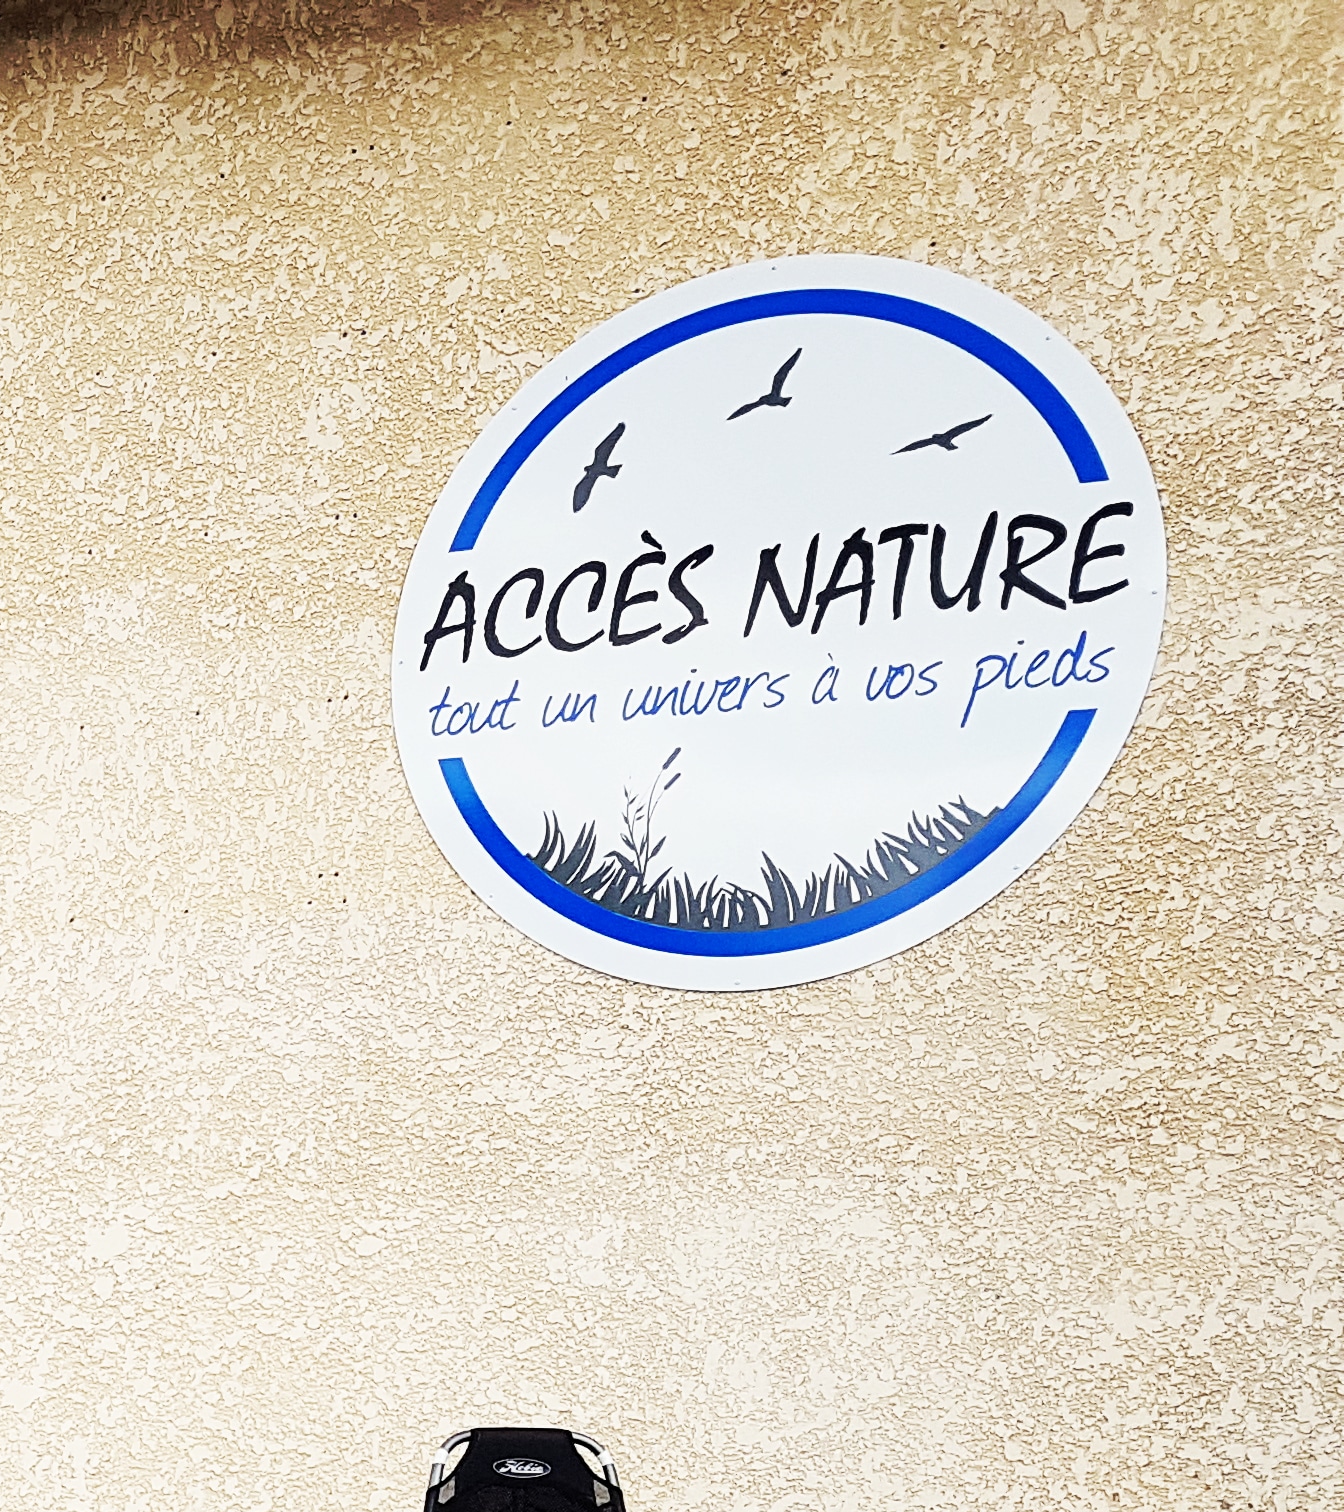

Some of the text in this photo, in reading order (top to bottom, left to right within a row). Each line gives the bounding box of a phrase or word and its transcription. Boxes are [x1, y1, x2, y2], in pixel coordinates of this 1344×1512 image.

[419, 501, 1134, 672] ACCÈS NATURE
[429, 630, 1116, 737] tout un univers à vos pieds
